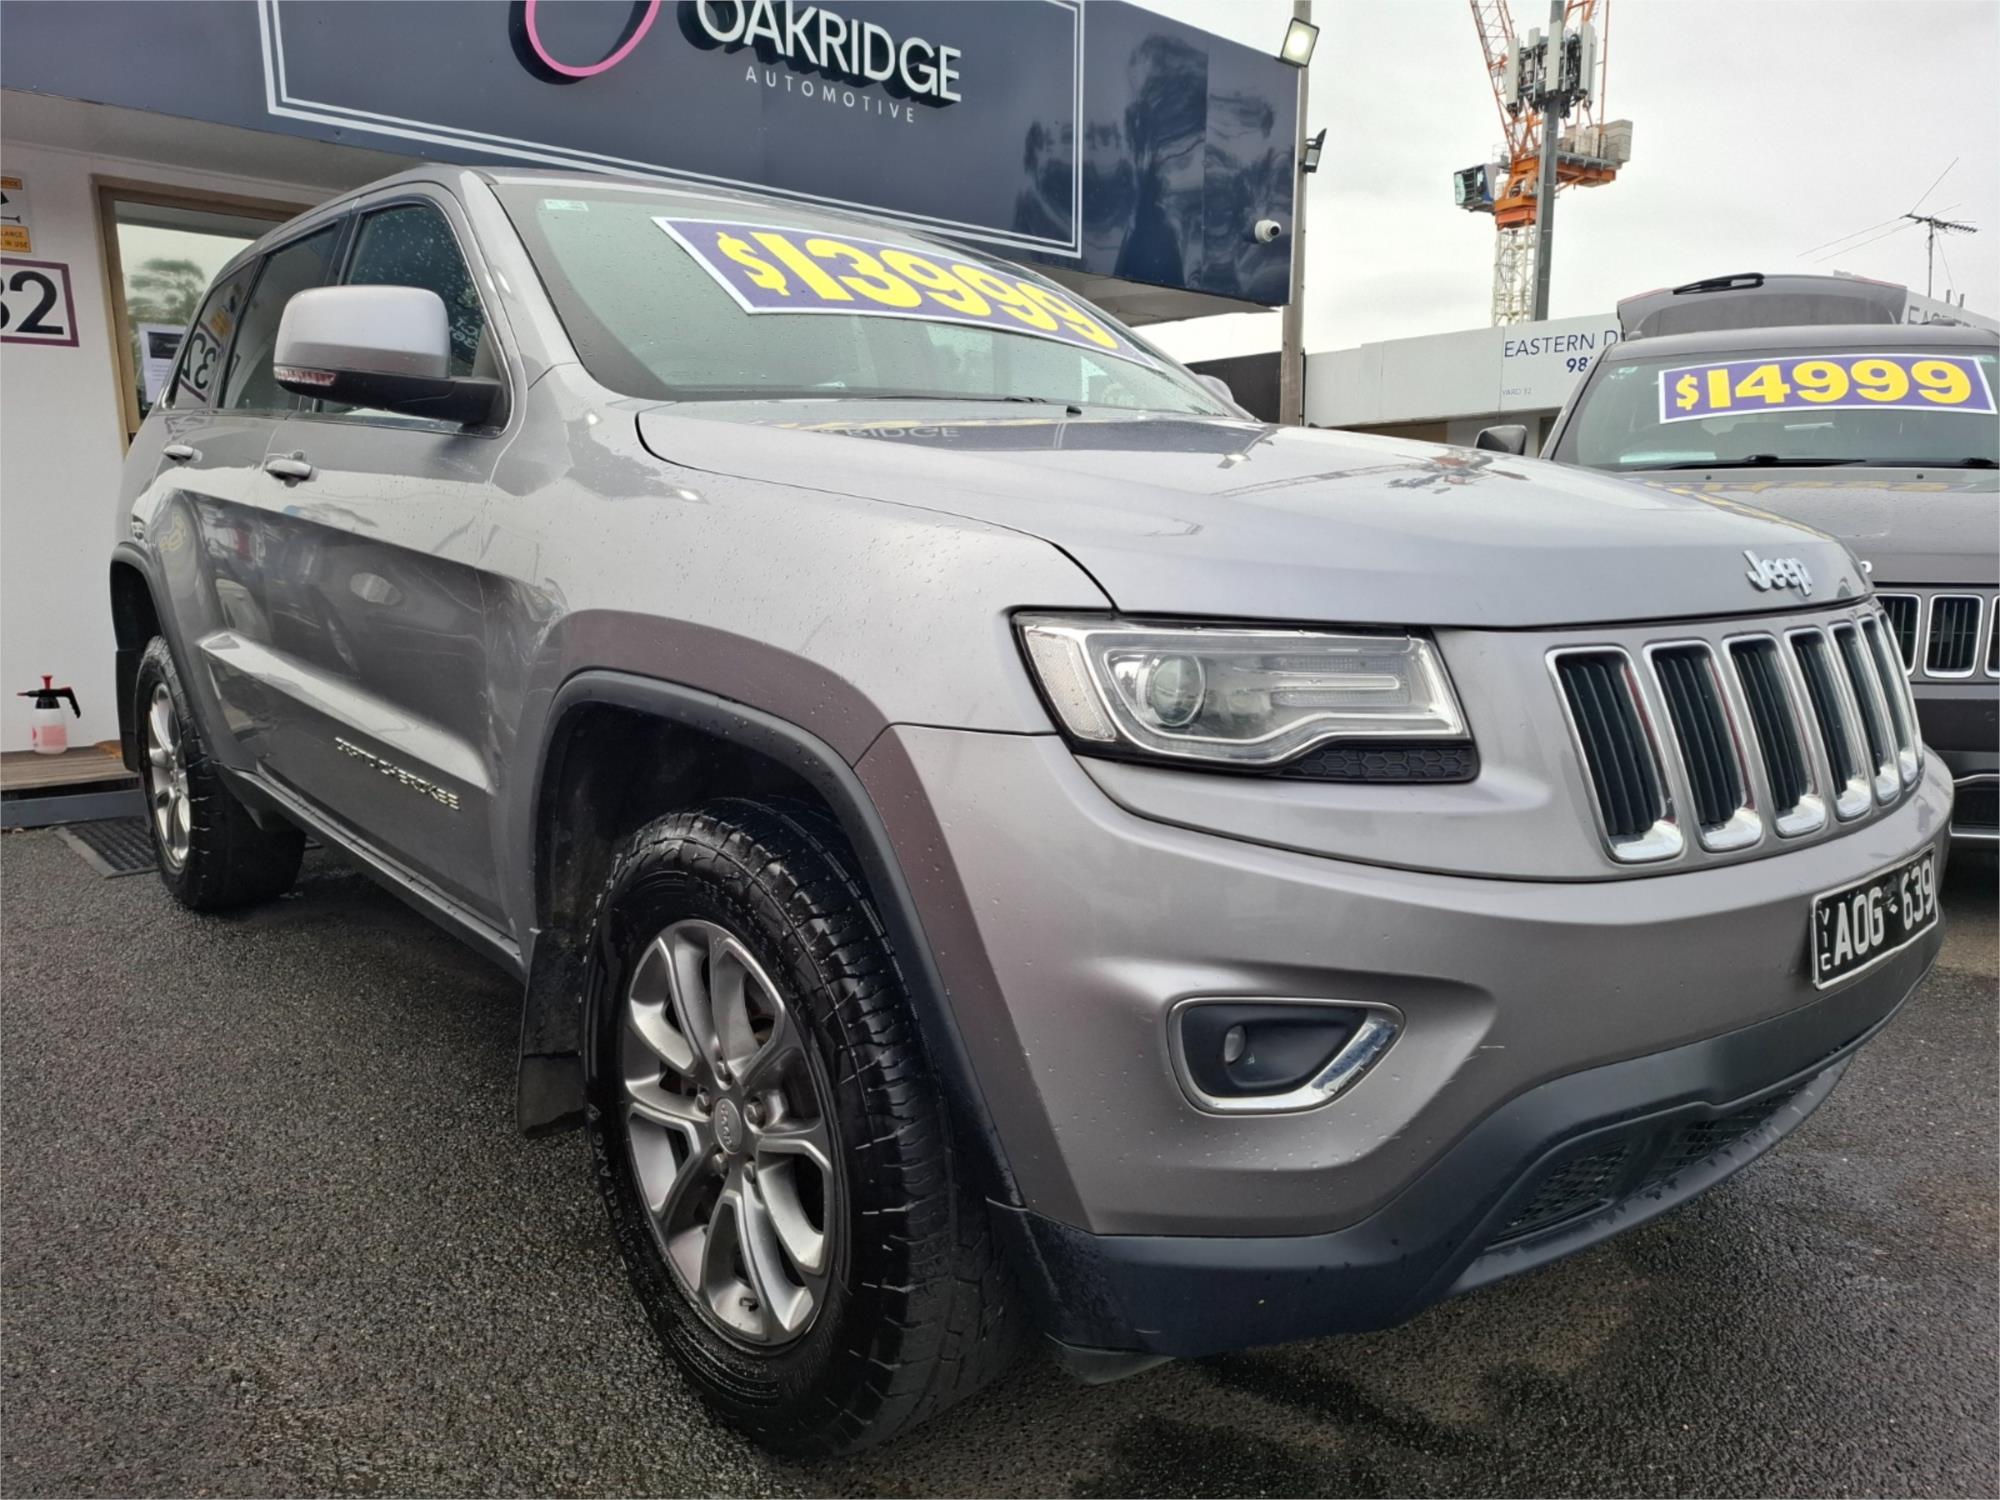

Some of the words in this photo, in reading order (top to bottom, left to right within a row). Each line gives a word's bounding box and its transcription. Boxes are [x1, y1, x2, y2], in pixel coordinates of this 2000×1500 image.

[697, 0, 962, 102] OAKRIDGE
[745, 66, 915, 123] AUTOMOTIVE
[716, 231, 1118, 350] $13999
[1503, 333, 1596, 358] EASTERN
[1566, 356, 1593, 373] 98
[1675, 358, 1972, 411] $14999
[1744, 549, 1812, 597] Jeep
[1901, 859, 1934, 930] 639
